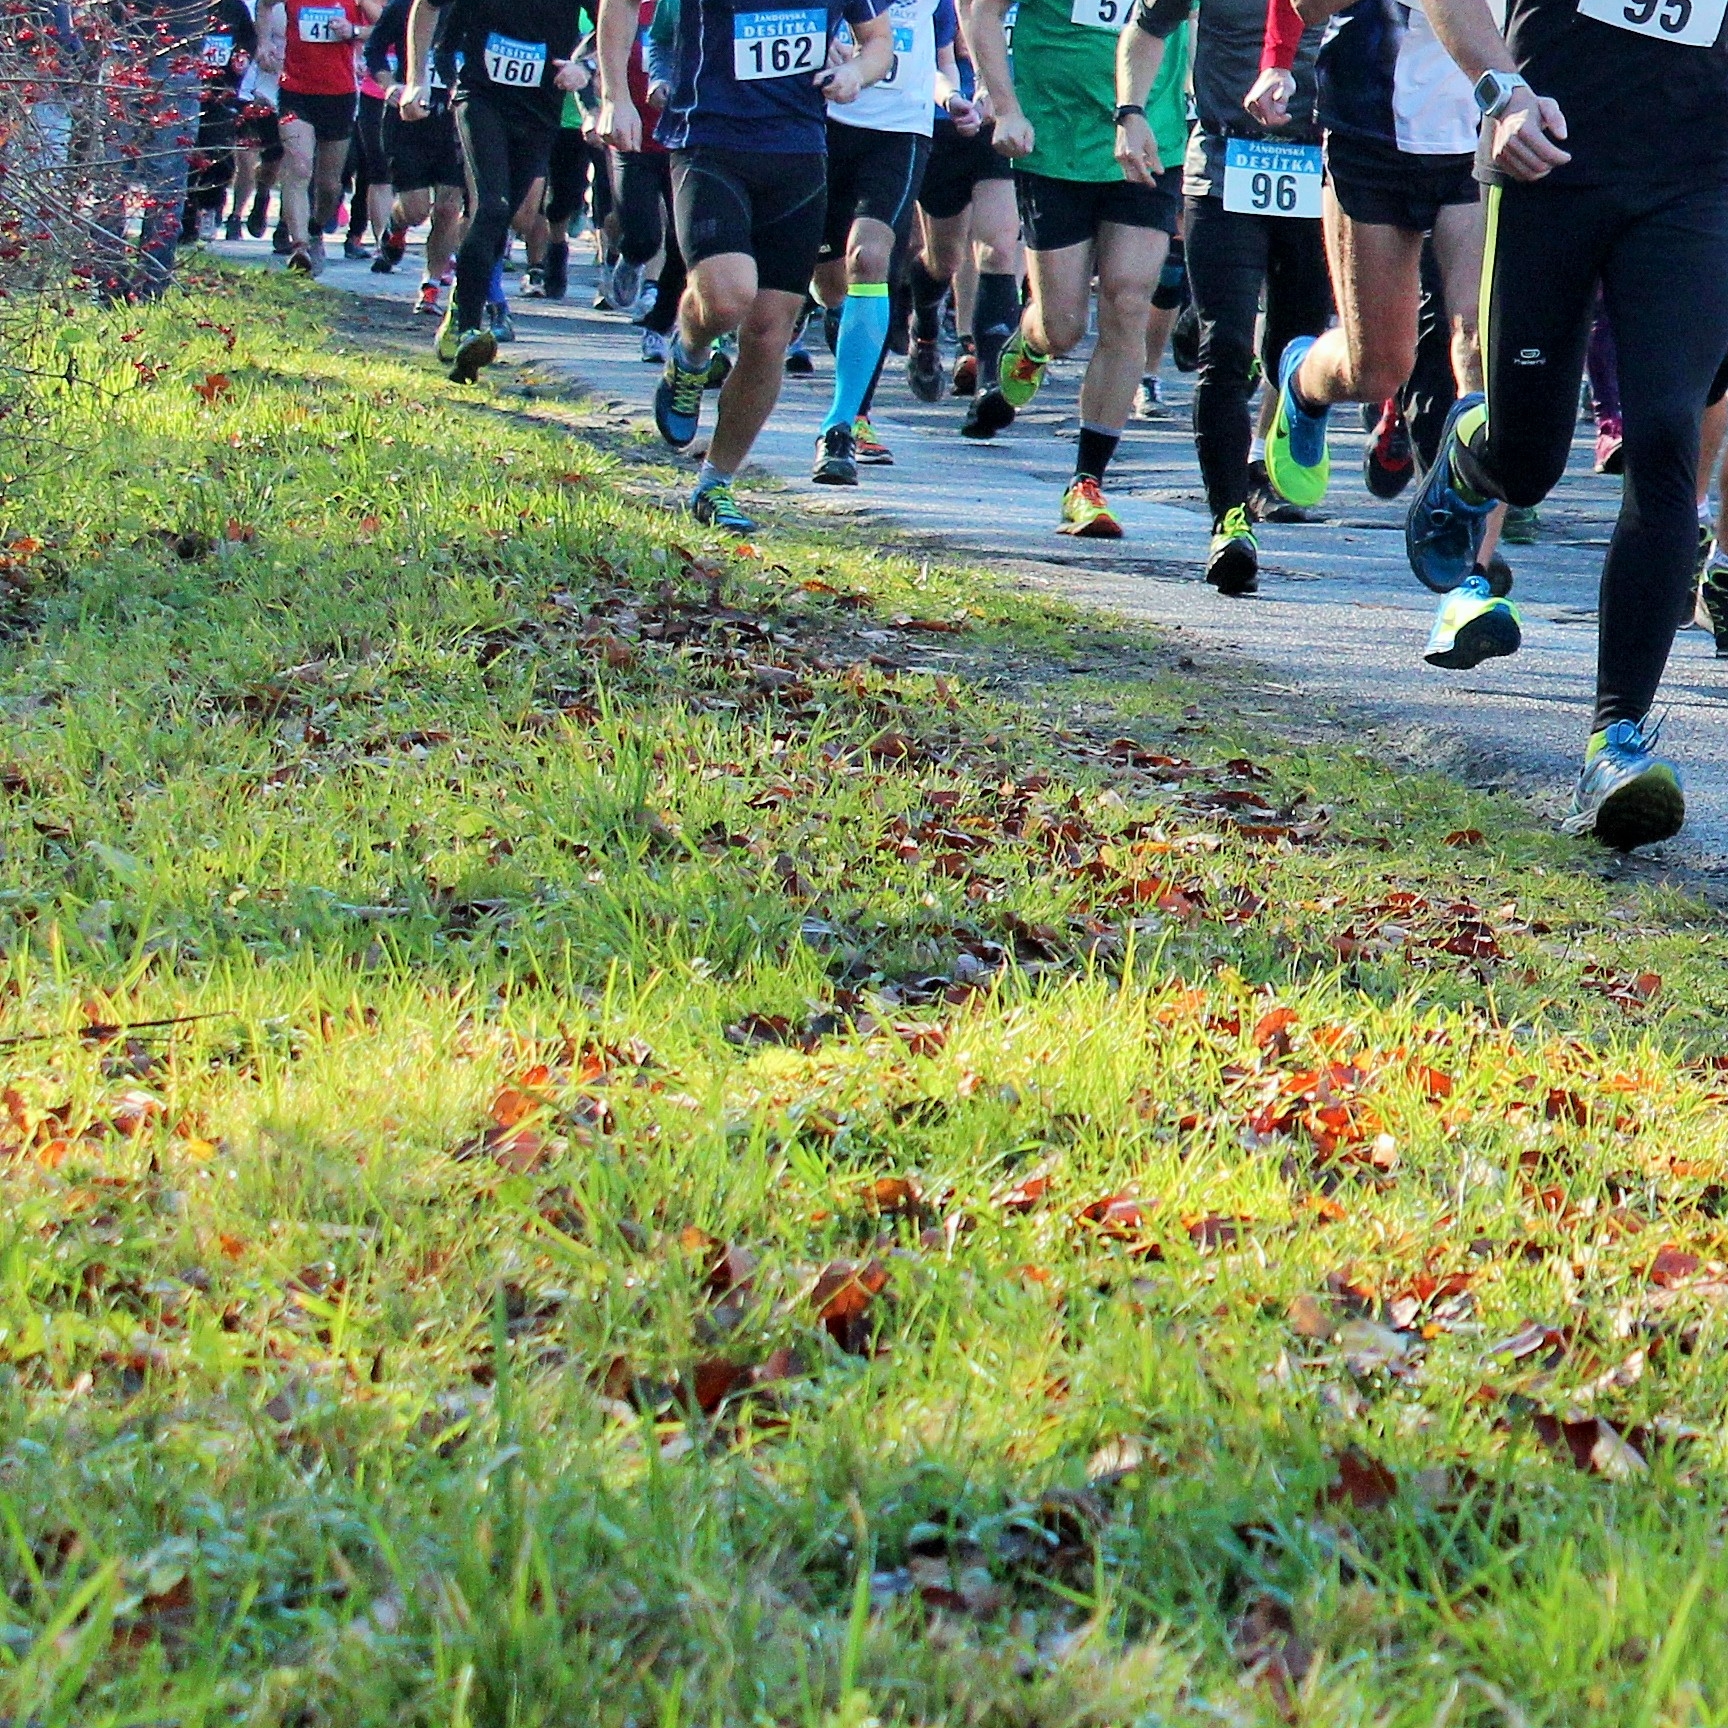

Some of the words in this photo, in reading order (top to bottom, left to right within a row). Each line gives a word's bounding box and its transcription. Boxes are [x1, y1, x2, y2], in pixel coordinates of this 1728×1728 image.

[754, 11, 807, 23] ŽANDOVSKÁ
[743, 20, 817, 38] DESÍTKA
[749, 36, 813, 73] 162
[492, 56, 536, 84] 160
[1249, 142, 1305, 157] ŽANDOVSKÁ
[1236, 154, 1316, 172] DESÍTKA
[1251, 172, 1297, 211] 96
